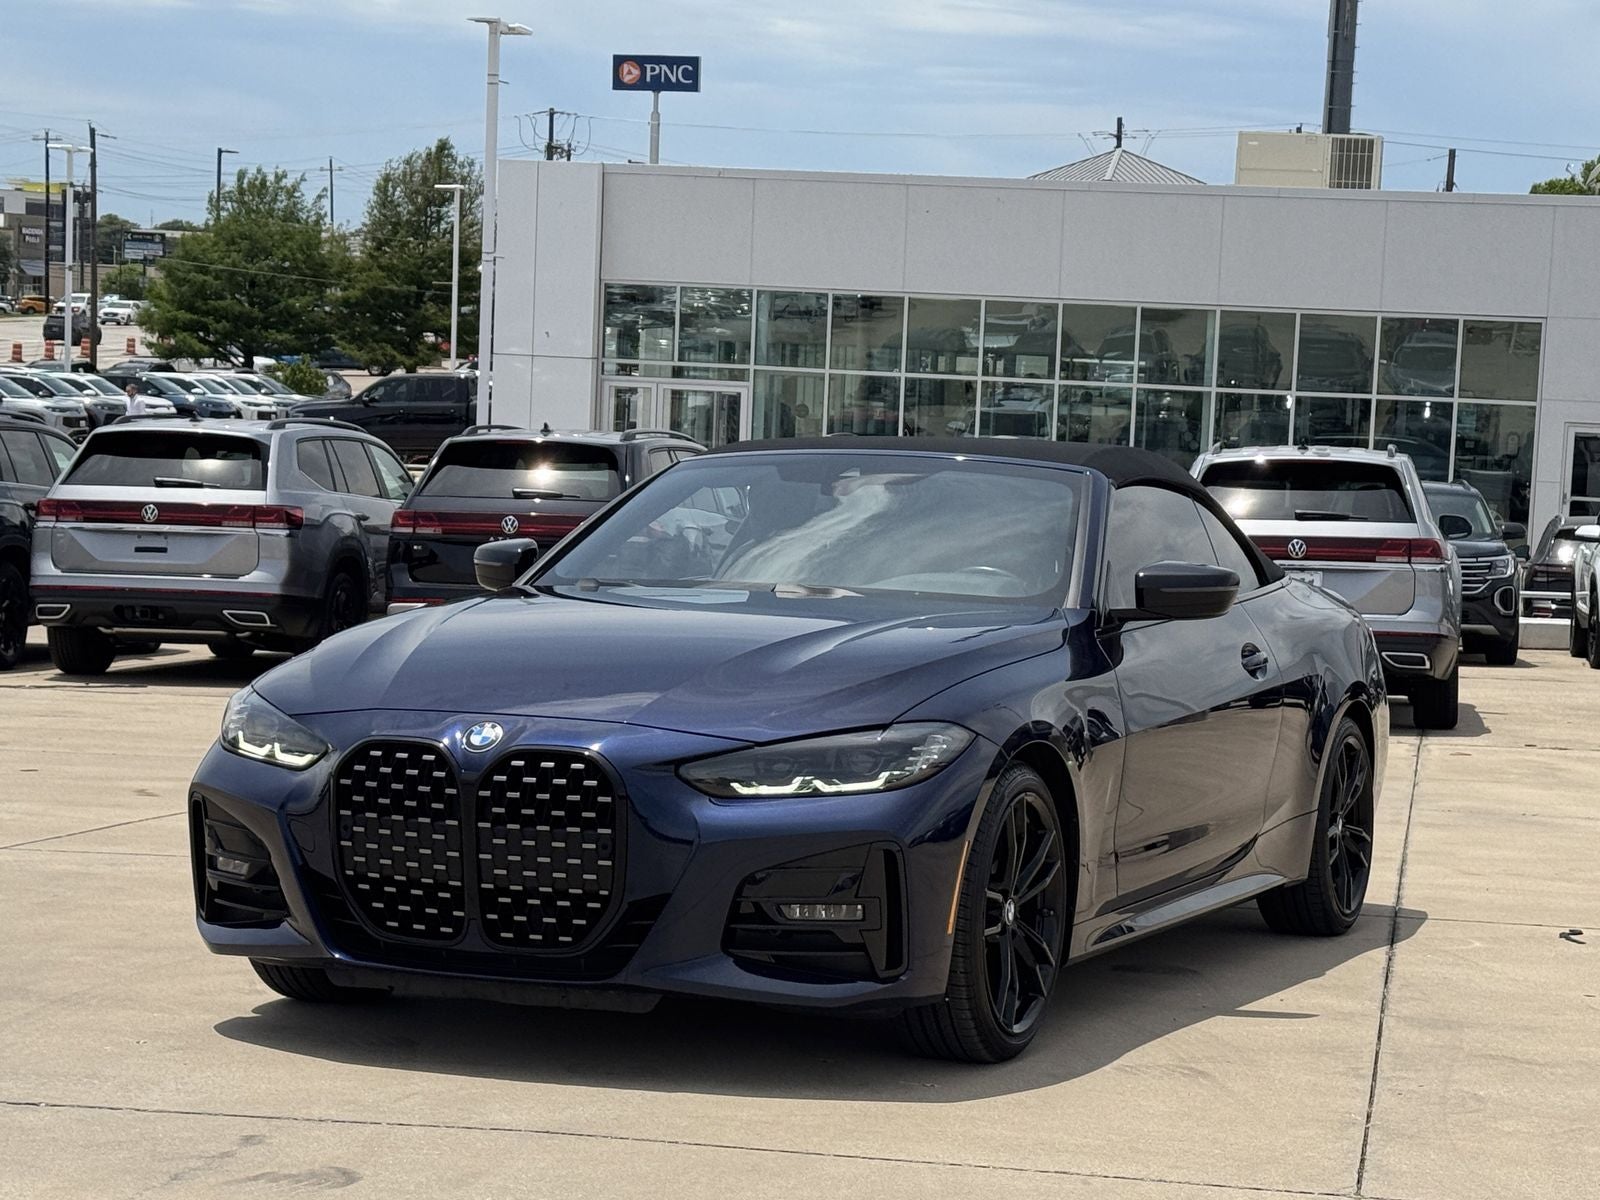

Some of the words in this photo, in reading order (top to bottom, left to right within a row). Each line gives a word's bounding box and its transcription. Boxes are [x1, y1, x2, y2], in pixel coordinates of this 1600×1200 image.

[644, 63, 693, 83] PNC
[141, 504, 158, 522] VW
[501, 515, 518, 534] VW
[1288, 539, 1306, 558] VW
